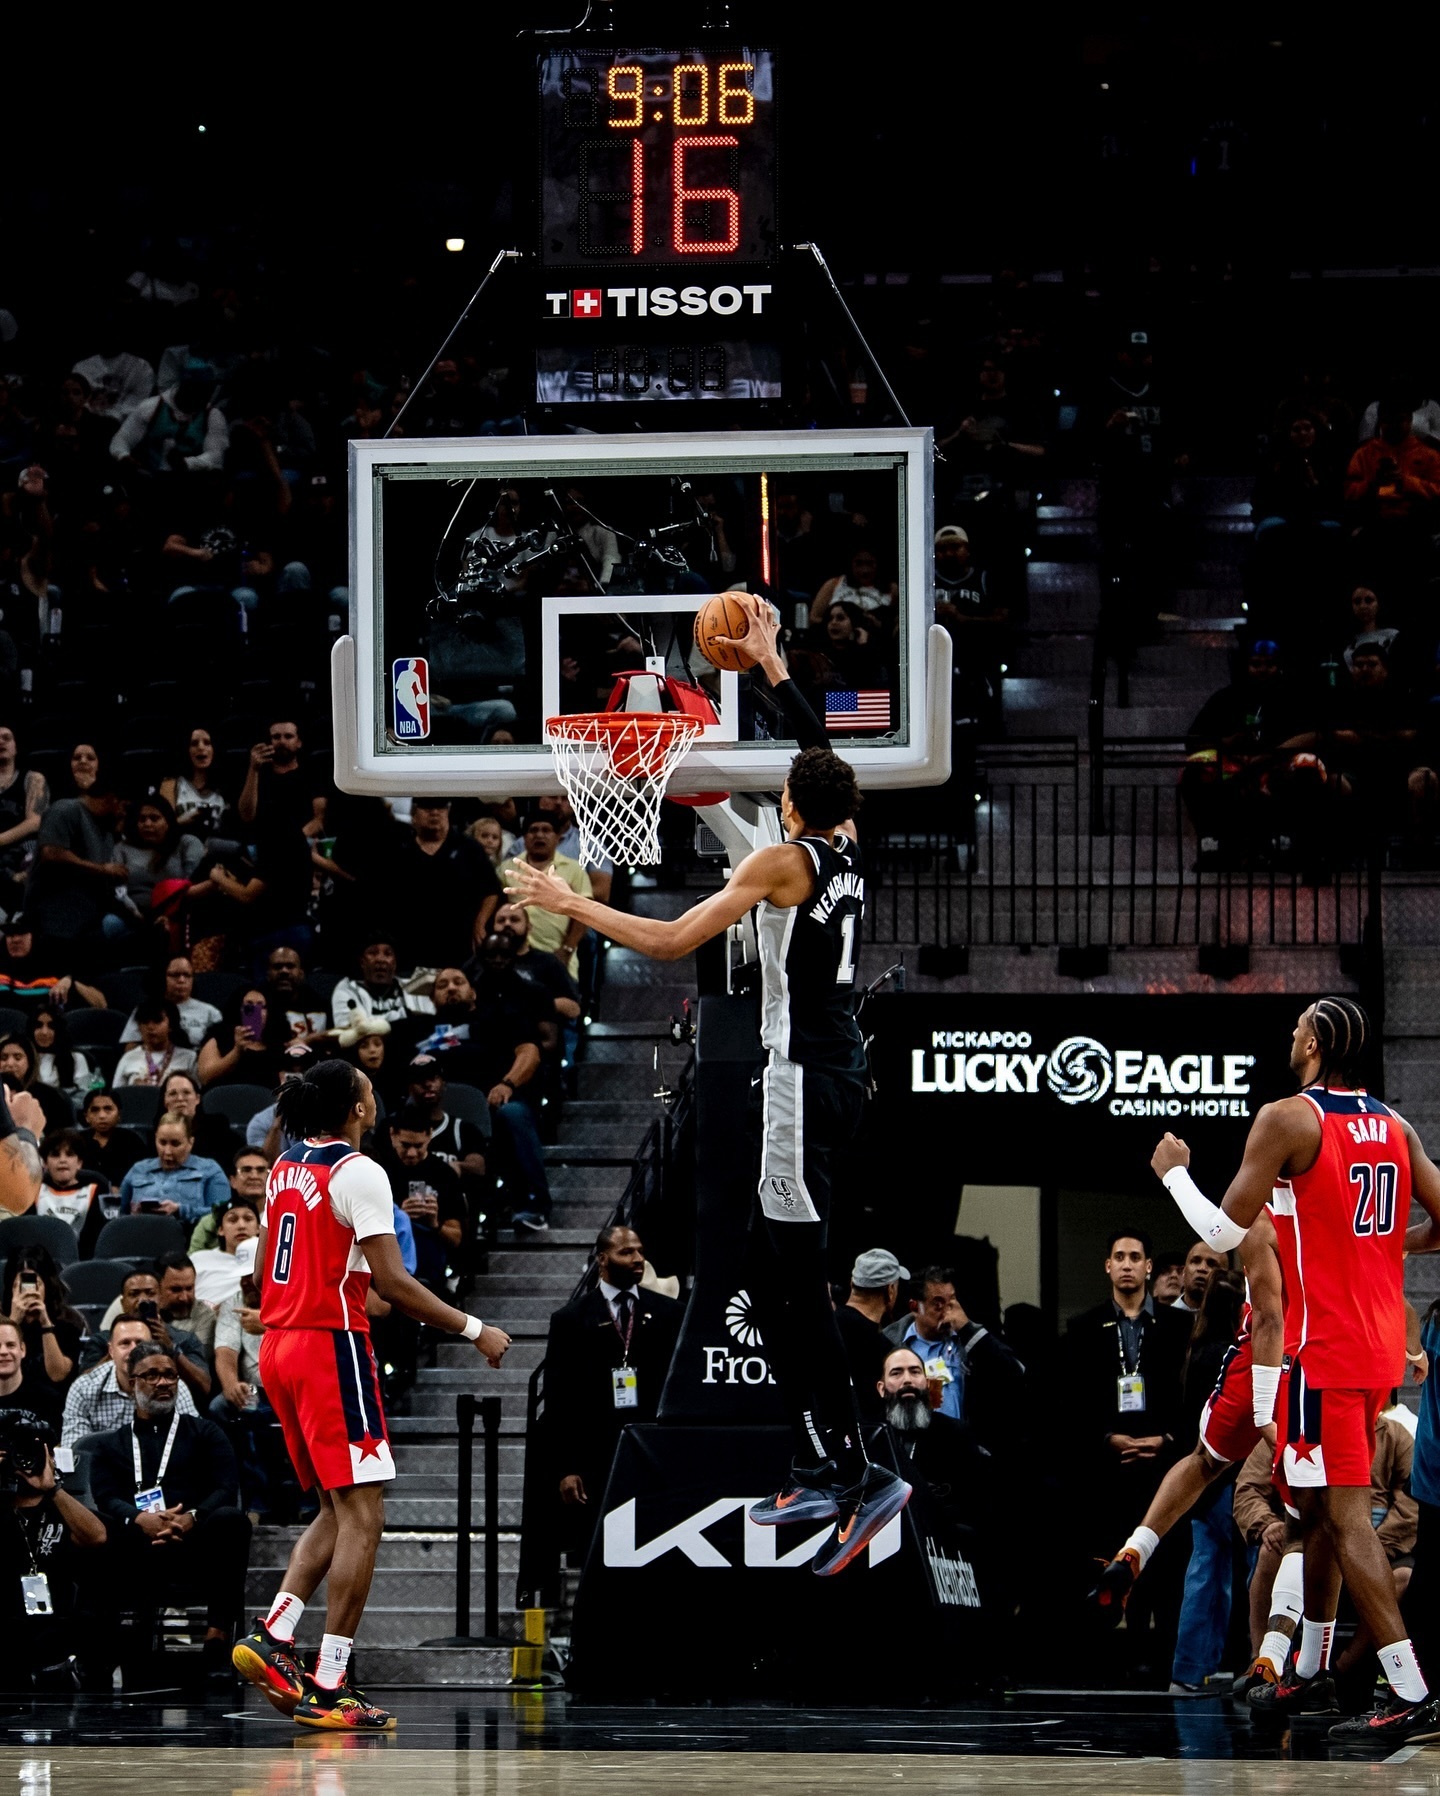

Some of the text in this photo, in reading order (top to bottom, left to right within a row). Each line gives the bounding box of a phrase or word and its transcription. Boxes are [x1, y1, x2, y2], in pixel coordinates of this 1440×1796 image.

[608, 64, 754, 127] 9:06
[633, 136, 739, 254] 16
[607, 285, 771, 317] TISSOT
[400, 720, 416, 734] NBA
[836, 914, 856, 984] 1
[932, 1031, 1032, 1049] KICKAPOO
[912, 1050, 1047, 1093] LUCKY
[1347, 1118, 1388, 1144] SARR
[1350, 1162, 1399, 1237] 20
[272, 1212, 297, 1284] 8
